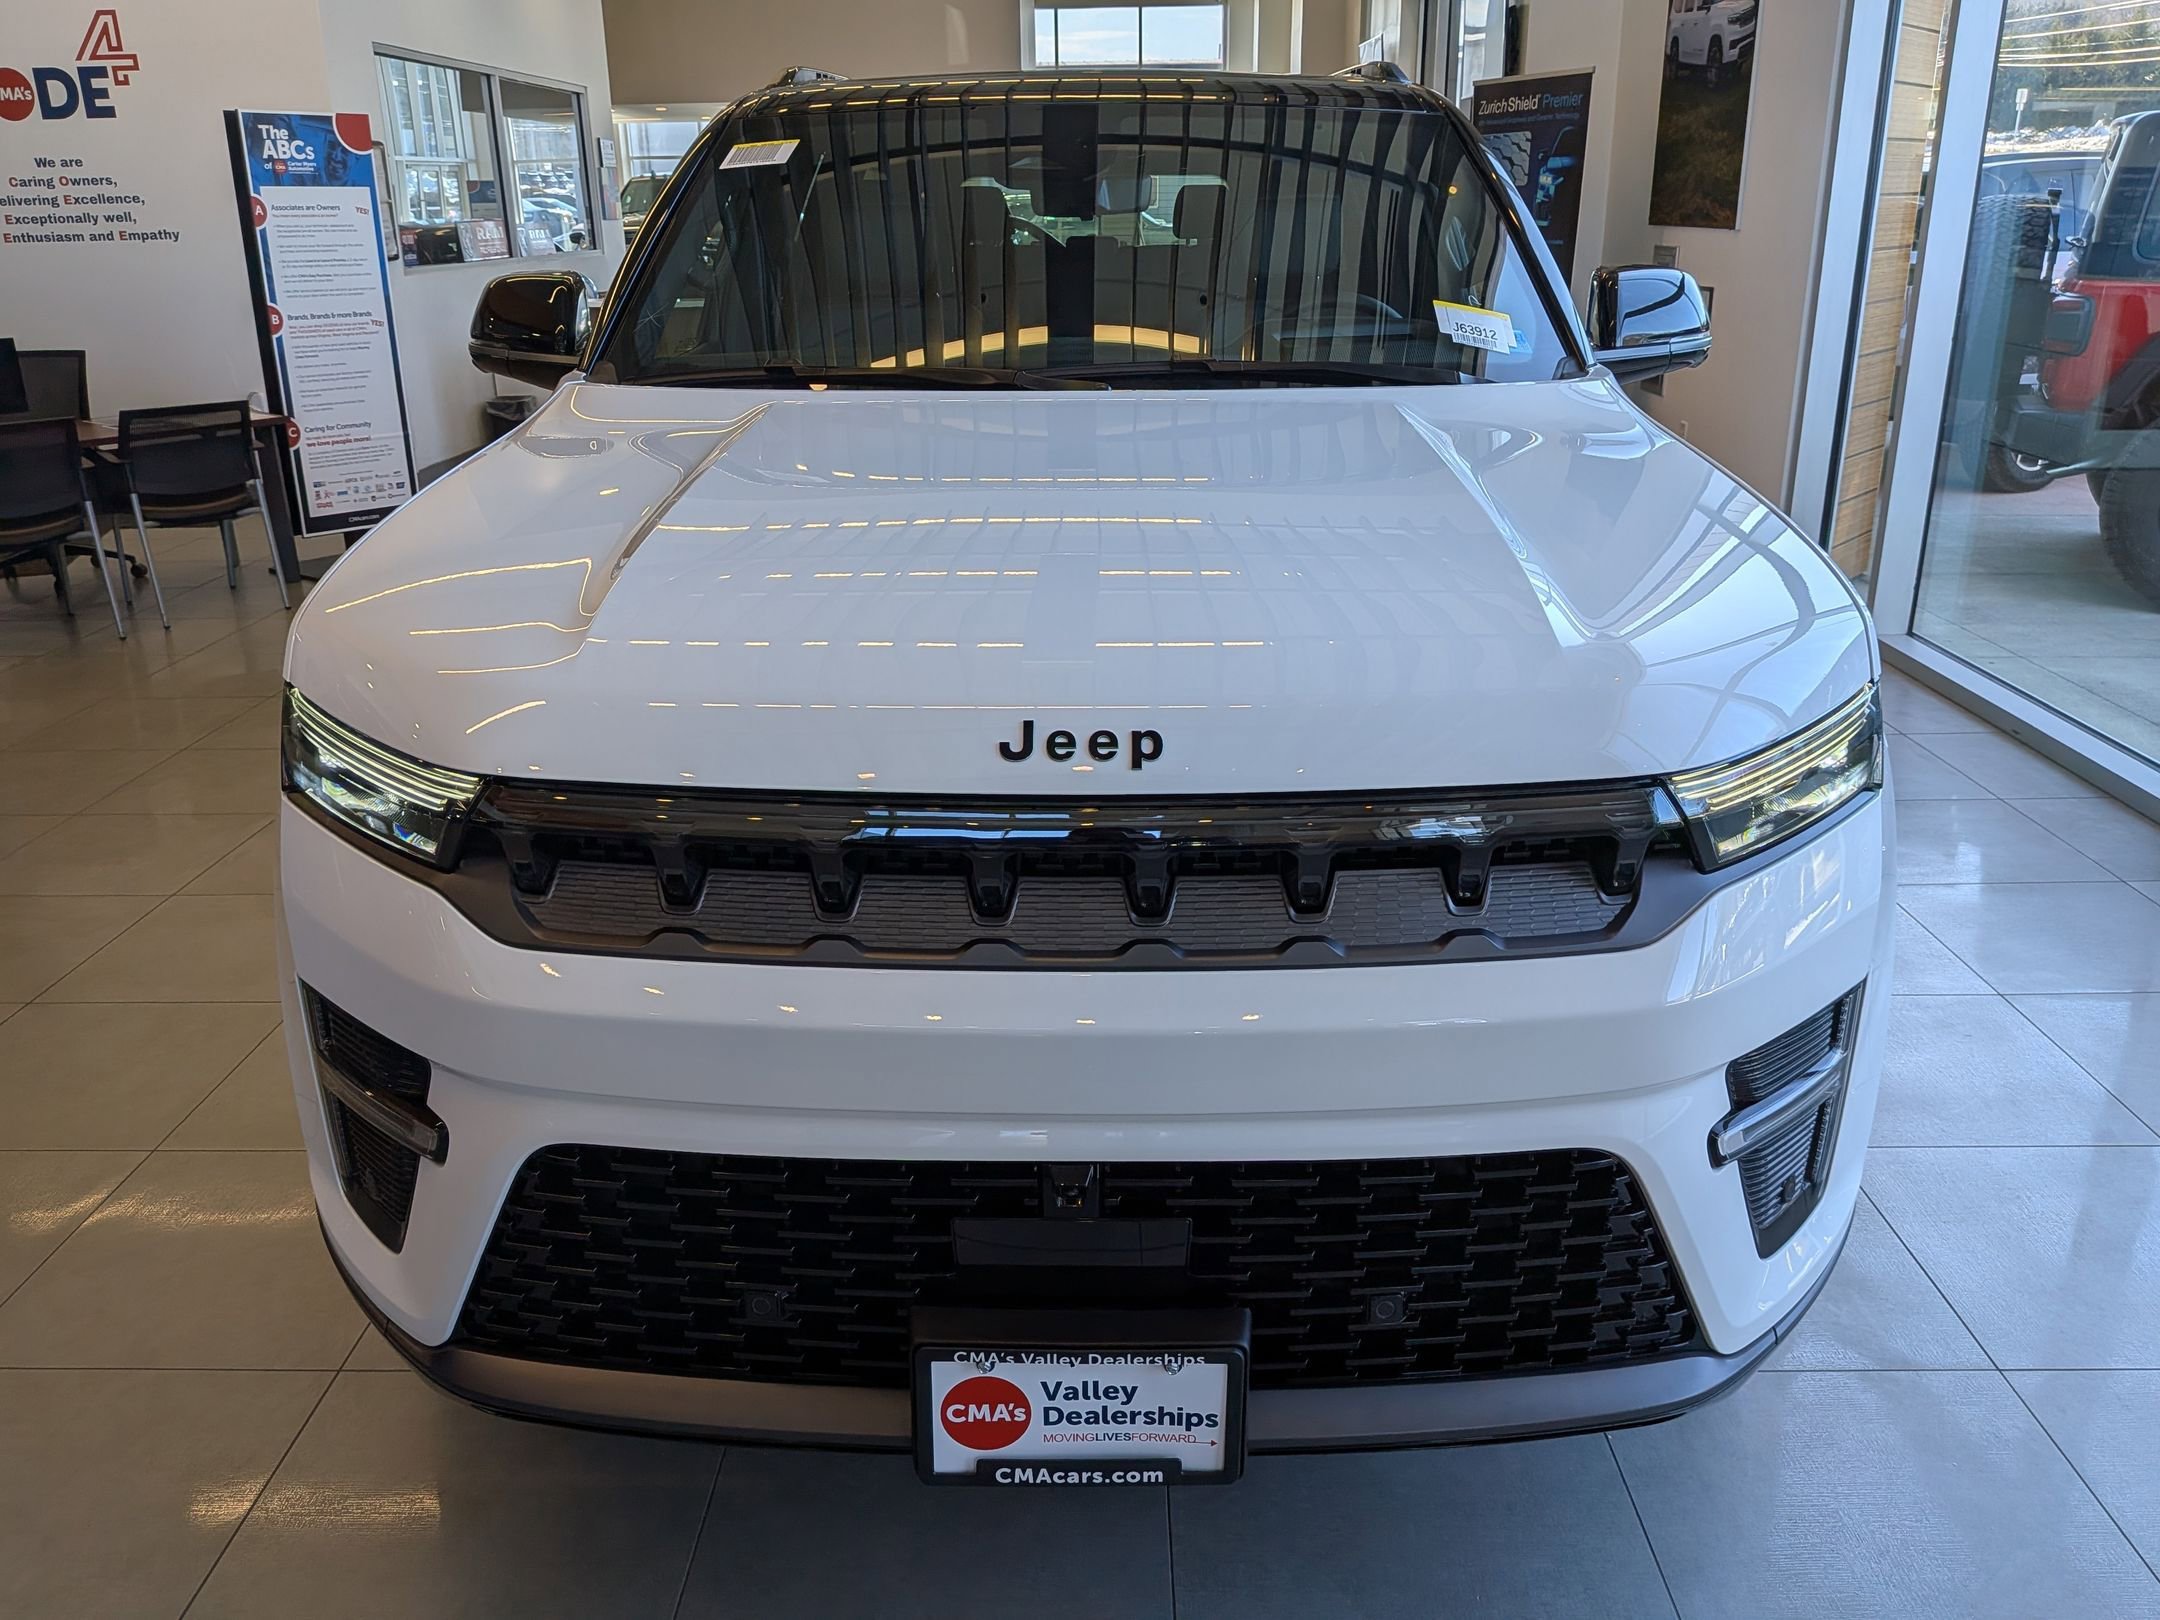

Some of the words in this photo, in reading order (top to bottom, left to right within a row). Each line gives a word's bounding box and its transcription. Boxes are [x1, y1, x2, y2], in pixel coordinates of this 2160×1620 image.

[0, 86, 33, 101] MA's
[1542, 92, 1584, 108] Premier
[257, 124, 289, 140] The
[262, 139, 315, 160] ABCs
[34, 157, 56, 168] We
[60, 158, 83, 168] are
[264, 162, 273, 170] of
[8, 176, 56, 190] Caring
[59, 175, 118, 188] Owners,
[0, 194, 60, 208] elivering
[63, 193, 145, 206] Excellence,
[271, 204, 305, 212] Associates
[316, 204, 341, 212] Owners
[255, 204, 265, 216] A
[355, 206, 370, 216] YES!
[4, 212, 99, 227] Exceptionally
[103, 211, 137, 225] well,
[3, 231, 85, 243] Enthusiasm
[89, 230, 115, 242] and
[118, 229, 180, 243] Empathy
[271, 314, 280, 325] B
[310, 312, 331, 321] Brands
[336, 312, 352, 320] more
[1452, 321, 1499, 341] J63912
[288, 427, 298, 438] C
[304, 425, 326, 434] Caring
[326, 424, 336, 432] for
[336, 421, 372, 431] Community
[998, 719, 1164, 771] Jeep
[953, 1350, 1015, 1365] CMA's
[1021, 1352, 1082, 1367] Valley
[1088, 1352, 1206, 1367] Dealerships
[1040, 1380, 1139, 1405] Valley
[945, 1402, 1028, 1424] CMA's
[1043, 1405, 1219, 1432] Dealerships
[995, 1467, 1164, 1484] CMAcars.com
